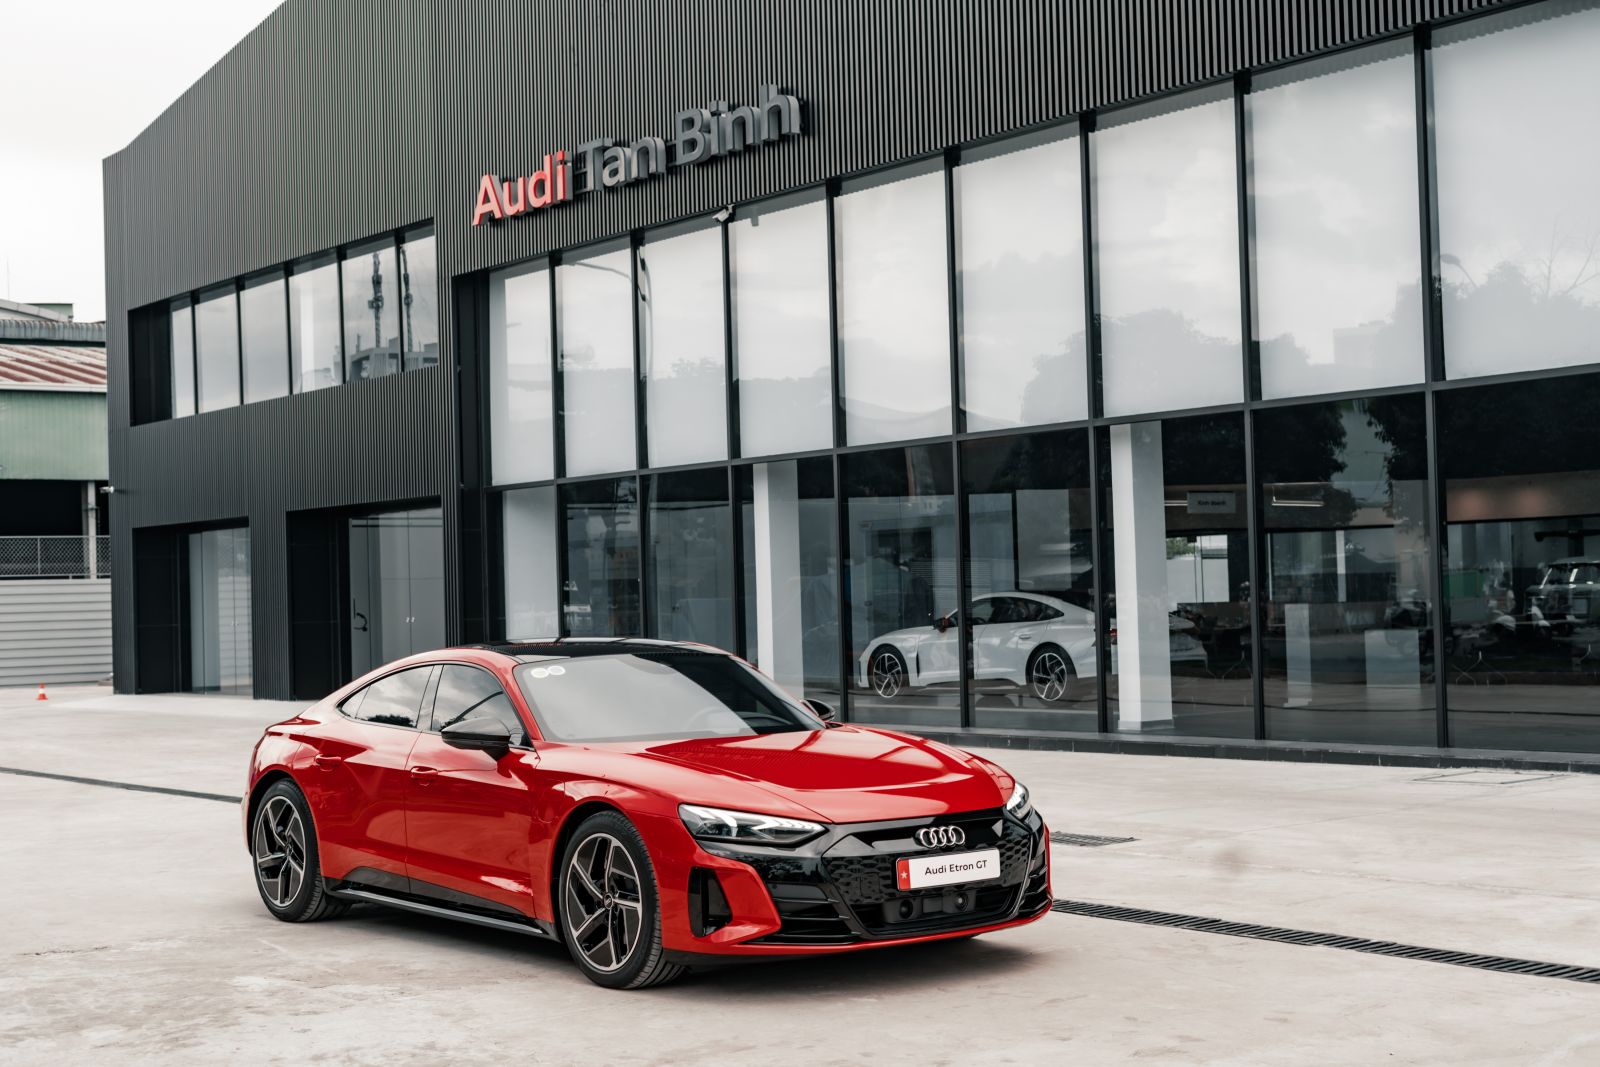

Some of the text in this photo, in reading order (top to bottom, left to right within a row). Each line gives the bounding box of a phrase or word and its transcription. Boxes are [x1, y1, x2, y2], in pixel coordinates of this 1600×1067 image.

[473, 84, 800, 226] Audi Tan Binh
[925, 860, 987, 875] Audi Etron GT
